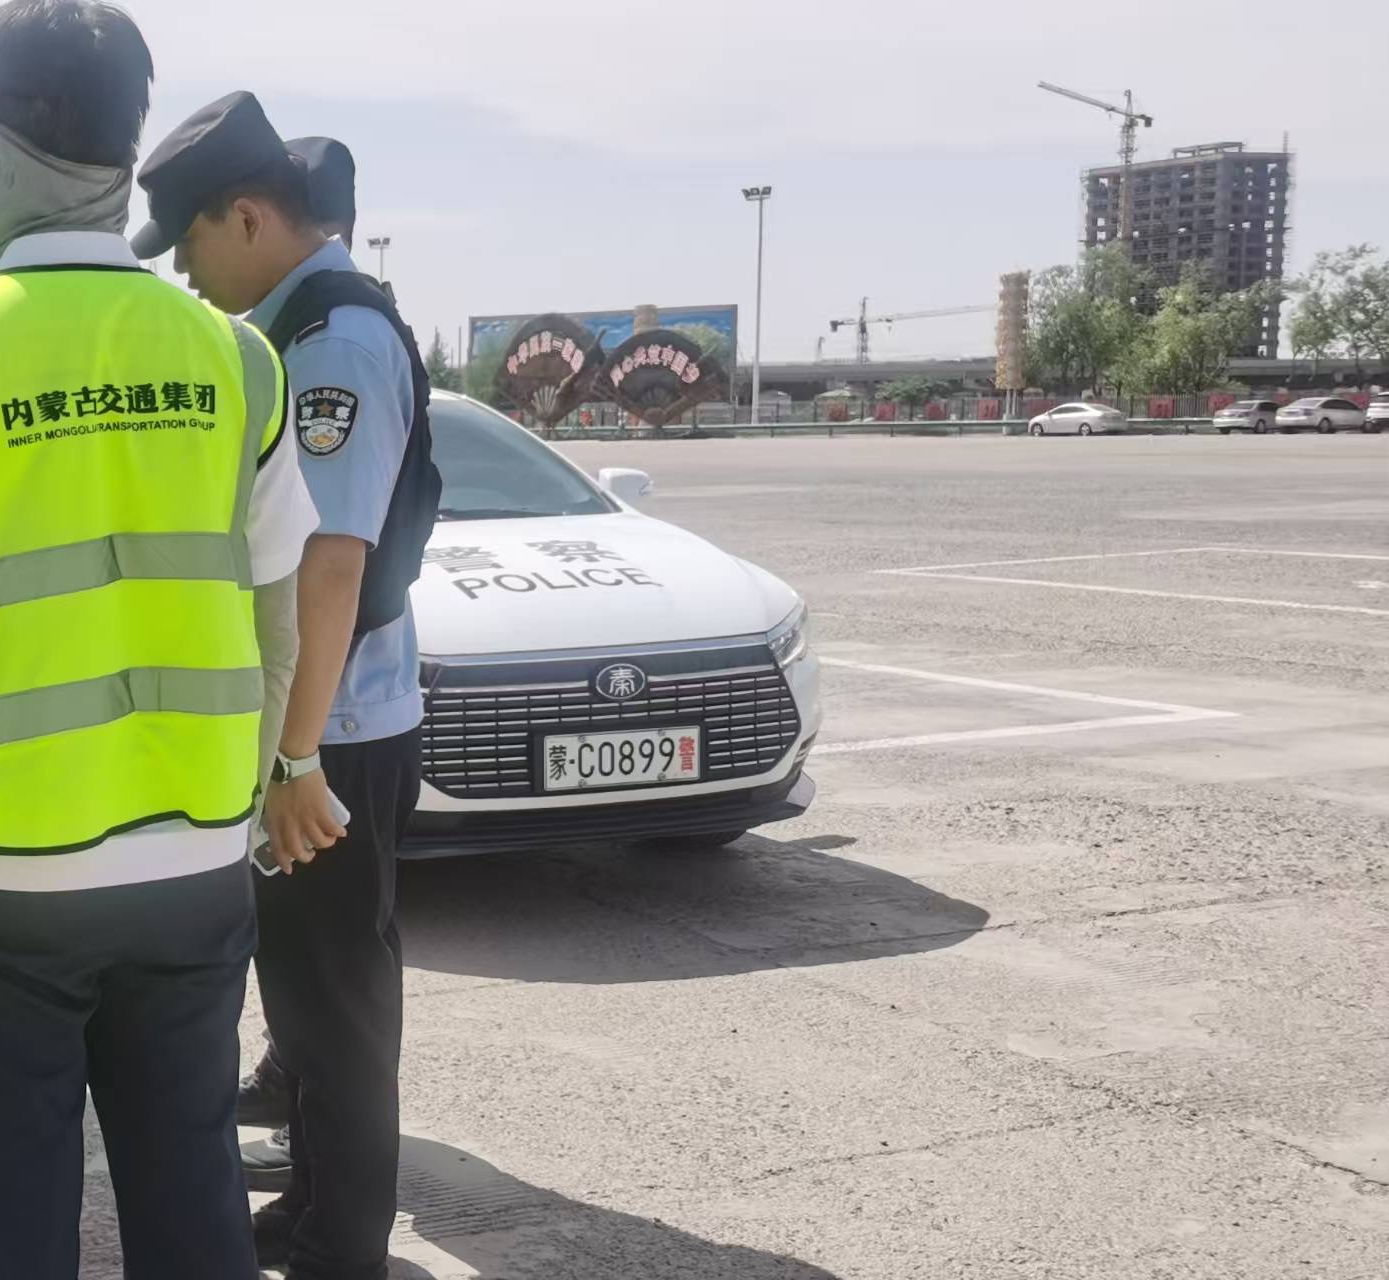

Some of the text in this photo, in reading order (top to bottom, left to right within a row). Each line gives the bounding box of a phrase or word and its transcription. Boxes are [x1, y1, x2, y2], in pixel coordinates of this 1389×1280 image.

[1, 381, 216, 431] 内蒙古交通集团
[8, 432, 43, 448] INNER
[46, 424, 97, 440] MONGOLI
[452, 568, 663, 600] POLICE
[609, 667, 636, 697] 秦
